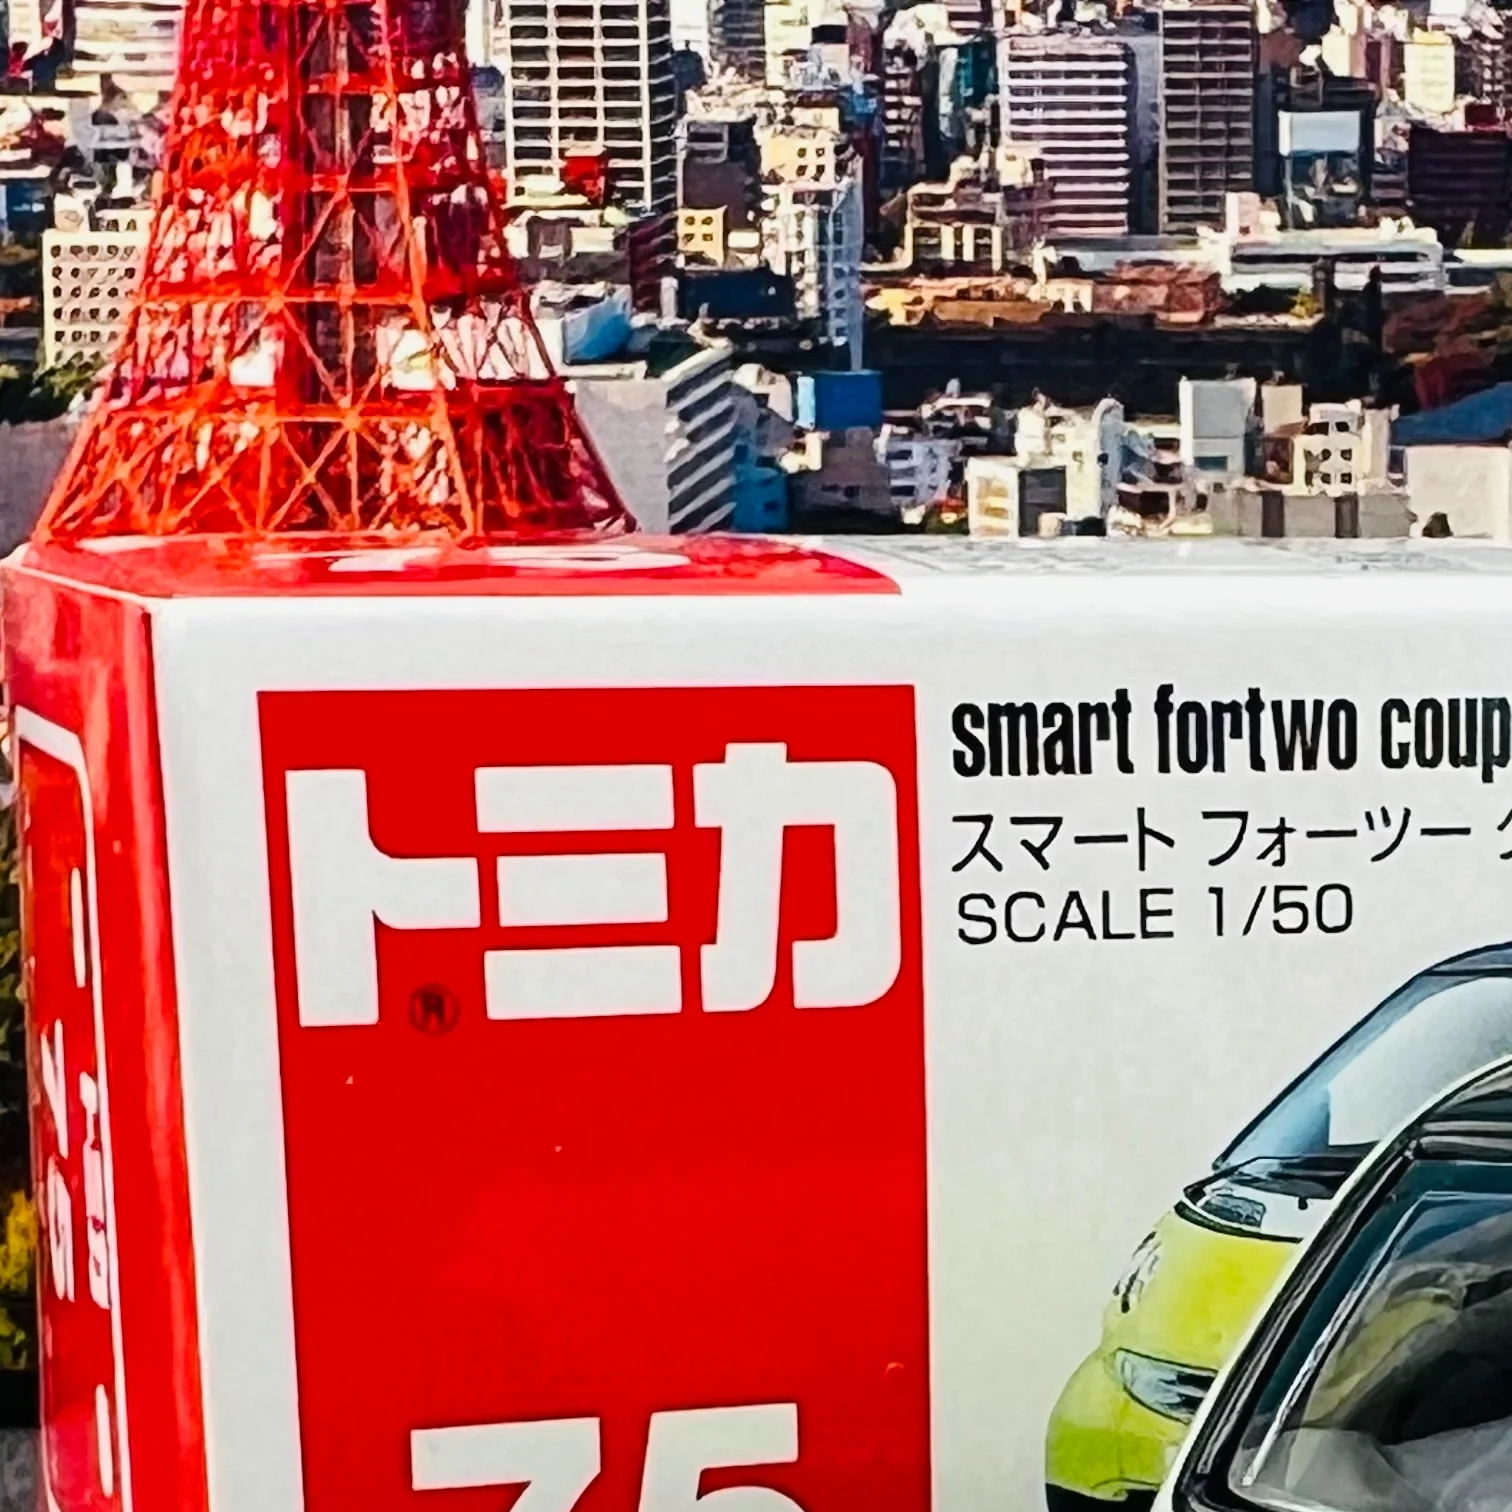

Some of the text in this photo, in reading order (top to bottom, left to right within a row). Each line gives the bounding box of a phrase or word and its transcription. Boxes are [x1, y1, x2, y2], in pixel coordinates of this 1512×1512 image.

[952, 689, 1134, 777] smart
[1154, 684, 1357, 773] fortwo
[952, 808, 1174, 872] スマート
[1202, 807, 1471, 867] フォーツー
[286, 743, 900, 1026] トミカ
[959, 884, 1352, 945] SCALE 1/50
